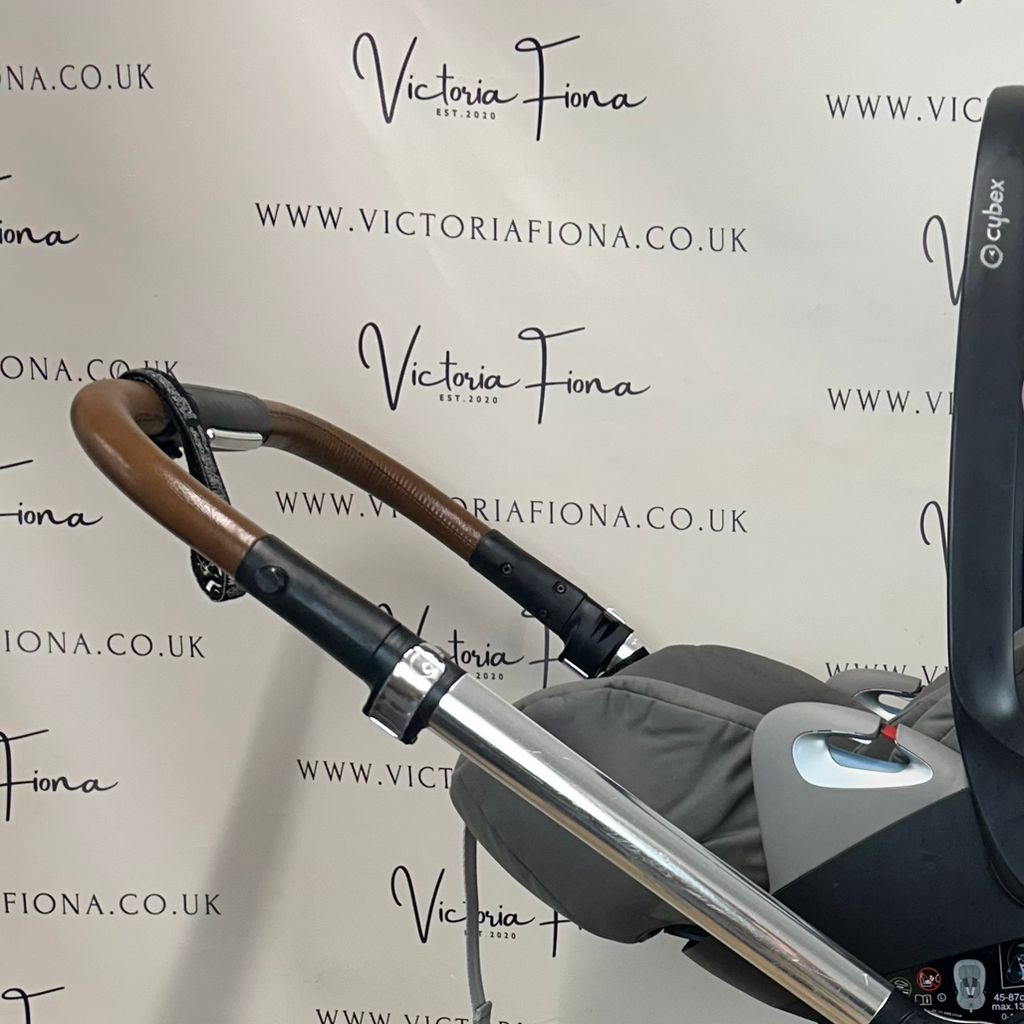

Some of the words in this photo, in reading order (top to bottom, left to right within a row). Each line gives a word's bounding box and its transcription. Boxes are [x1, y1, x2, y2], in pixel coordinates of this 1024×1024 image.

[0, 64, 154, 91] NA.CO.UK
[353, 32, 518, 124] Victoria
[515, 35, 647, 141] Fiona
[436, 108, 496, 120] EST.2020
[255, 203, 747, 253] WWW.VICTORIAFIONA.CO.UK
[981, 178, 1011, 242] cybex
[358, 322, 520, 411] Victoria
[517, 327, 651, 424] Fiona
[440, 394, 498, 404] EST.2020
[275, 491, 748, 533] WWW.VRIAFIONA.CO.UK
[0, 729, 118, 822] Fiona
[391, 865, 536, 944] Vicoria
